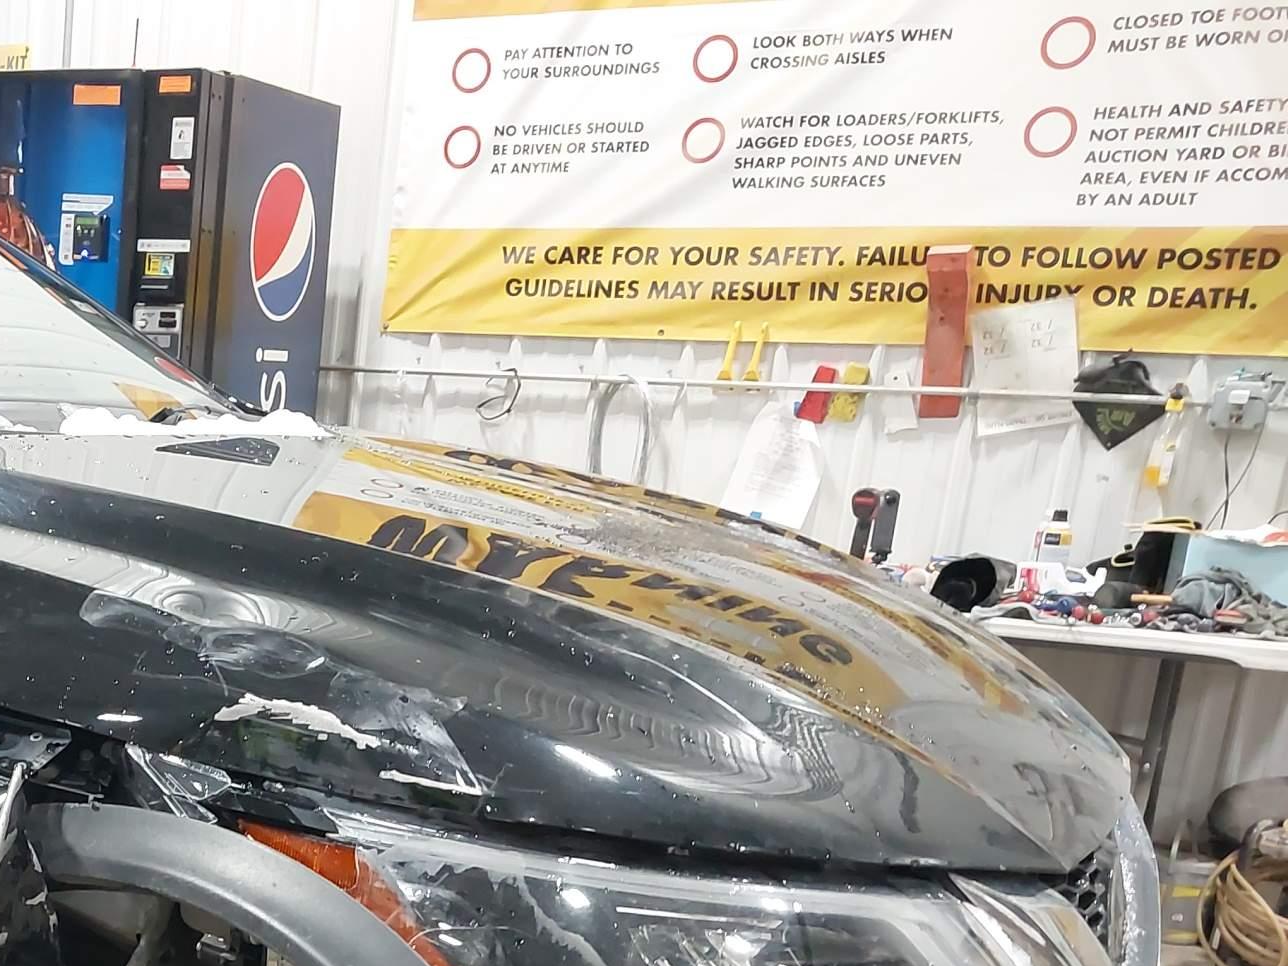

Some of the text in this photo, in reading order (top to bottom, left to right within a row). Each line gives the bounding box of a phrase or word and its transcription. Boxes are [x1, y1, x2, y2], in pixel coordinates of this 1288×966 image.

[1112, 6, 1288, 30] CLOSED TOE FOOT
[752, 28, 953, 49] LOOK BOTH WAYS WHEN
[1106, 37, 1160, 54] MUST
[1165, 35, 1188, 50] BE
[1195, 30, 1260, 48] WORN
[504, 43, 634, 61] PAY ATTENTION TO
[750, 50, 886, 70] CROSSING AISLES
[502, 62, 660, 80] YOUR SURROUNDINGS
[1093, 98, 1288, 120] HEALTH AND SAFETY
[494, 121, 644, 136] NO VEHICLES SHOULD
[740, 110, 1005, 129] WATCH FOR LOADERS/FORKLIFTS,
[736, 132, 974, 150] JAGGED EDGES, LOOSE PARTS,
[1088, 121, 1288, 142] NOT PERMIT CHILDRE
[492, 140, 650, 156] BE DRIVEN OR STARTED
[1084, 144, 1288, 164] AUCTION YARD OR BI
[490, 161, 570, 175] AT ANYTIME
[734, 153, 962, 170] SHARP POINTS AND UNEVEN
[732, 174, 886, 189] WALKING SURFACES
[1080, 172, 1133, 187] AREA,
[1139, 170, 1188, 184] EVEN
[1194, 170, 1210, 183] IF
[1076, 192, 1199, 206] BY AN ADULT
[502, 246, 1281, 270] WE CARE FOR YOUR SAFETY. FAILU TO FOLLOW POSTED
[505, 278, 640, 300] GUIDELINES
[648, 280, 704, 300] MAY
[710, 281, 800, 301] RESULT
[808, 282, 840, 302] IN
[848, 281, 928, 304] SERIO
[1092, 286, 1137, 308] OR
[1146, 286, 1259, 310] DEATH.
[255, 346, 290, 413] si
